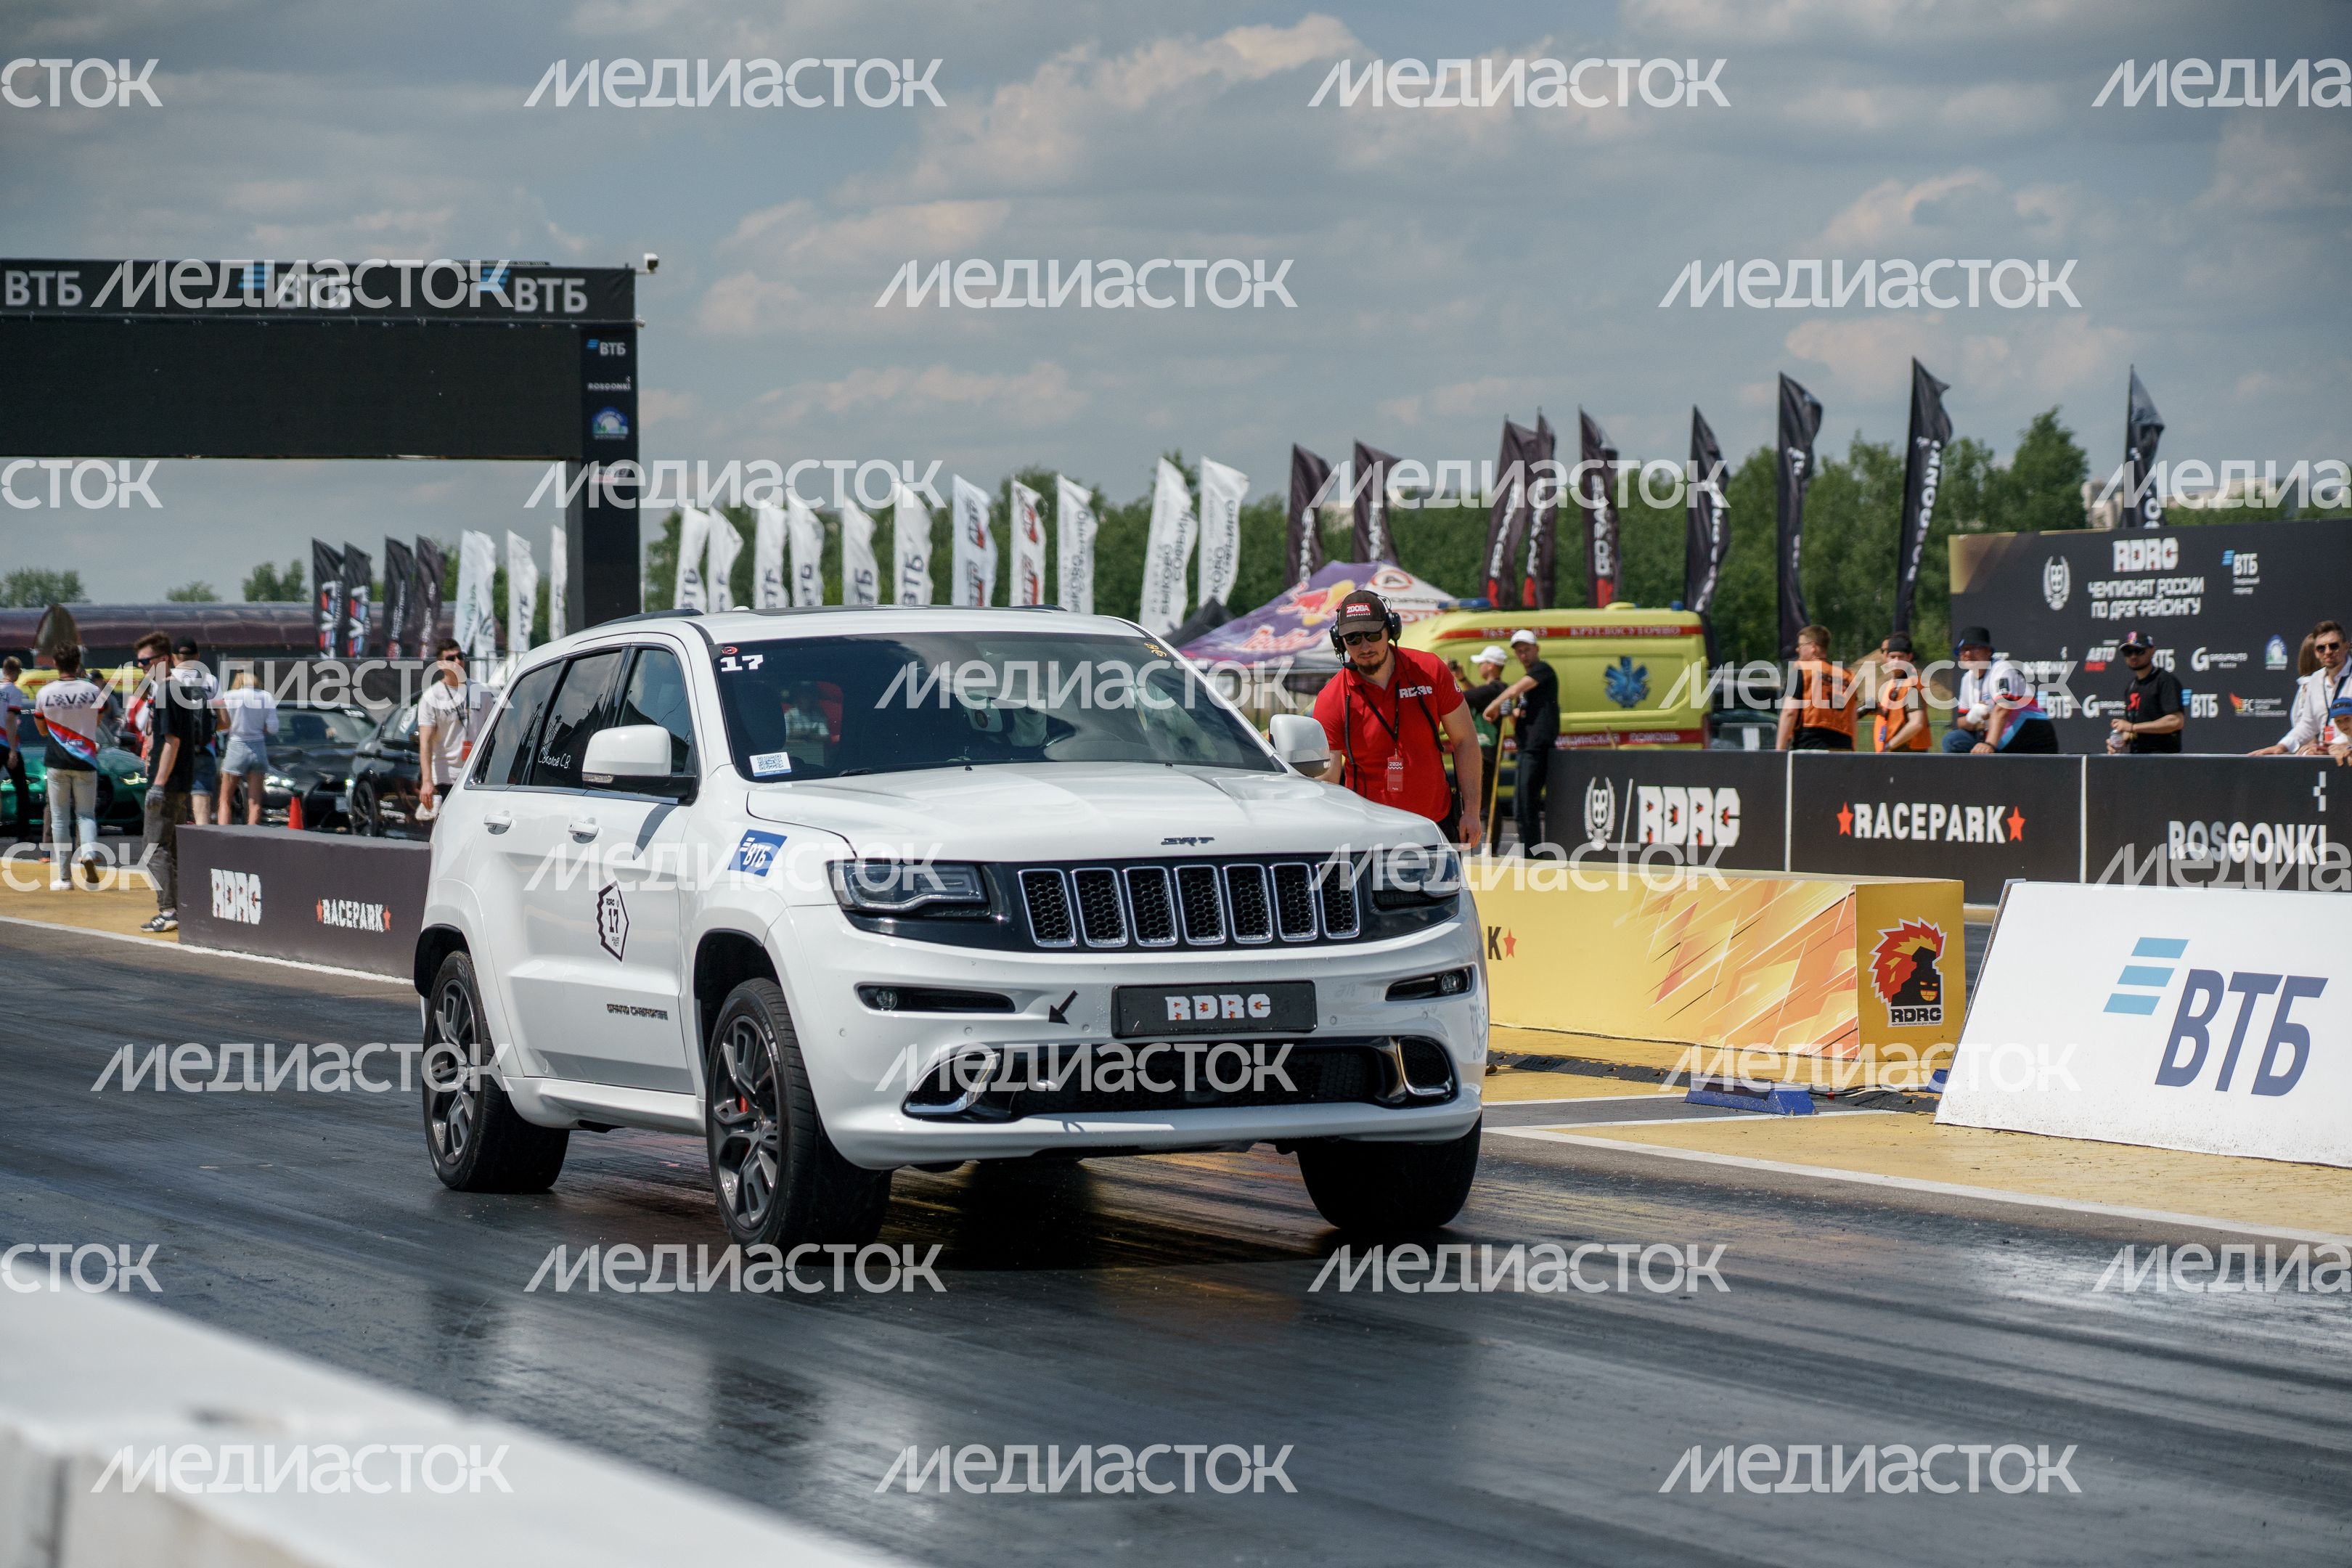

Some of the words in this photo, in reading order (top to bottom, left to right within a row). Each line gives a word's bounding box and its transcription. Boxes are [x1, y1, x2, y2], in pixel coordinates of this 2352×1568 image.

[5, 270, 83, 307] ВТБ
[278, 273, 353, 310] ВТБ
[514, 277, 588, 313] ВТБ
[600, 342, 626, 356] ВТБ
[1172, 510, 1191, 581] СОФЬИН
[2113, 537, 2179, 573] RDRC
[2232, 552, 2258, 576] ВТБ
[2088, 579, 2155, 600] ЧЕМПИОНАТ
[2156, 577, 2205, 597] РОССИИ
[1347, 605, 1370, 613] ZDOBA
[2091, 601, 2108, 618] ПО
[720, 654, 764, 672] 17
[2047, 695, 2073, 719] ВТБ
[2191, 693, 2219, 718] ВТБ
[1637, 785, 1741, 847] RDRC
[1853, 802, 2006, 844] RACEPARK
[742, 843, 772, 868] ВТБ
[2168, 820, 2327, 865] ROSGONKI
[211, 868, 262, 926] RDRC
[322, 898, 385, 933] RACEPARK
[608, 908, 618, 934] 17
[1164, 993, 1272, 1021] RDRC
[1891, 1007, 1942, 1023] RDRC
[2154, 968, 2329, 1098] ВТБ
